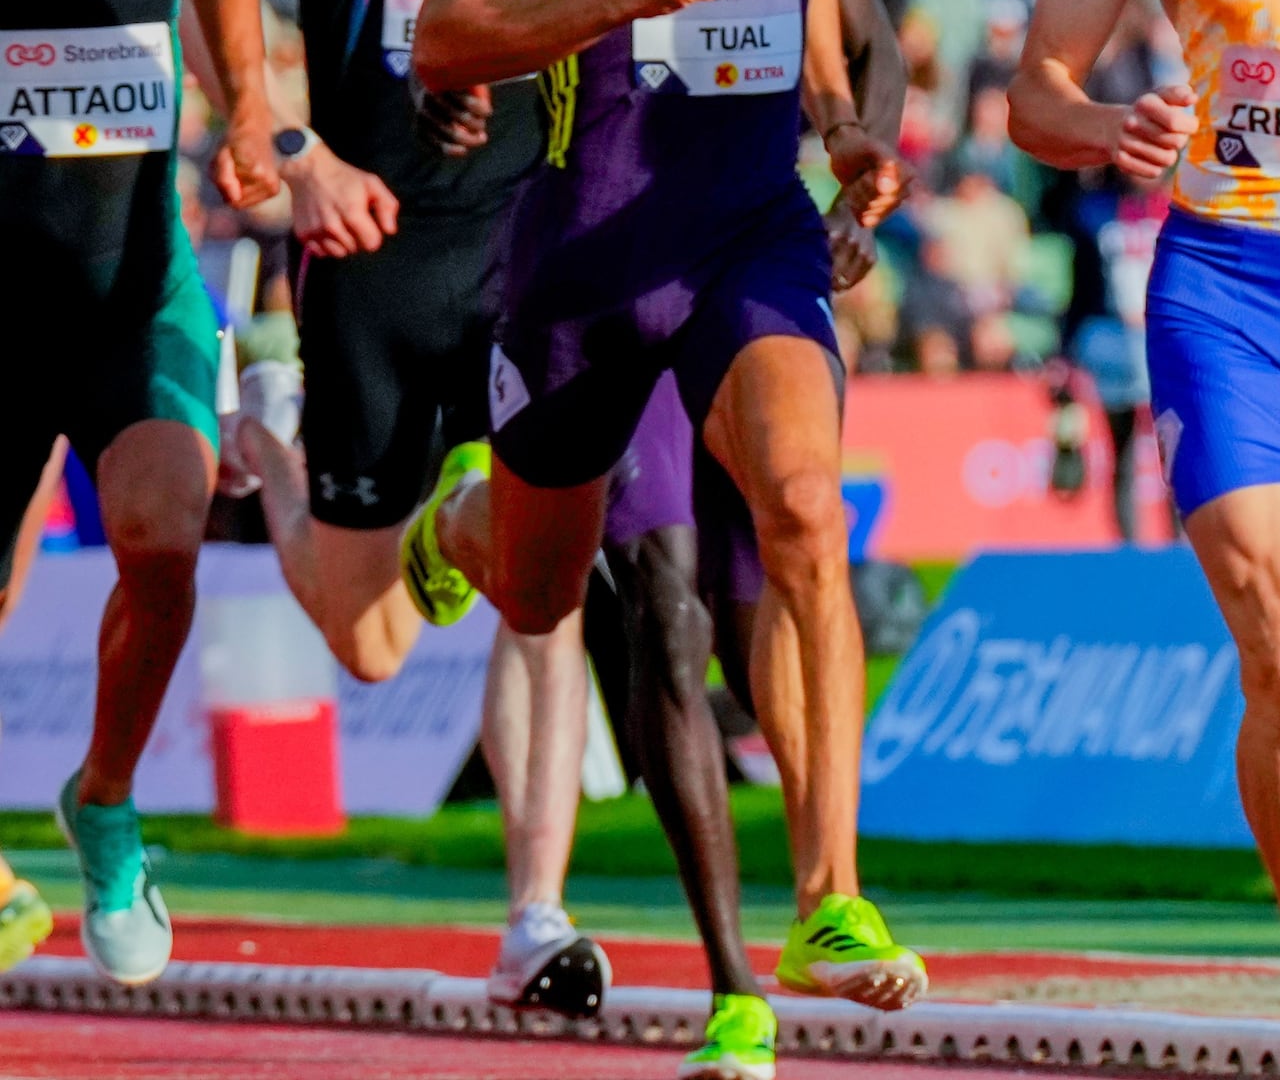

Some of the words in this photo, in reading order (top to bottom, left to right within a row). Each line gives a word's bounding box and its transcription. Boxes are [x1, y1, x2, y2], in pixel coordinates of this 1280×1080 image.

[699, 25, 770, 51] TUAL
[64, 41, 162, 63] Storebrand
[744, 66, 784, 81] EXTRA
[9, 81, 165, 116] ATTAOUI
[103, 124, 156, 141] EXTRA
